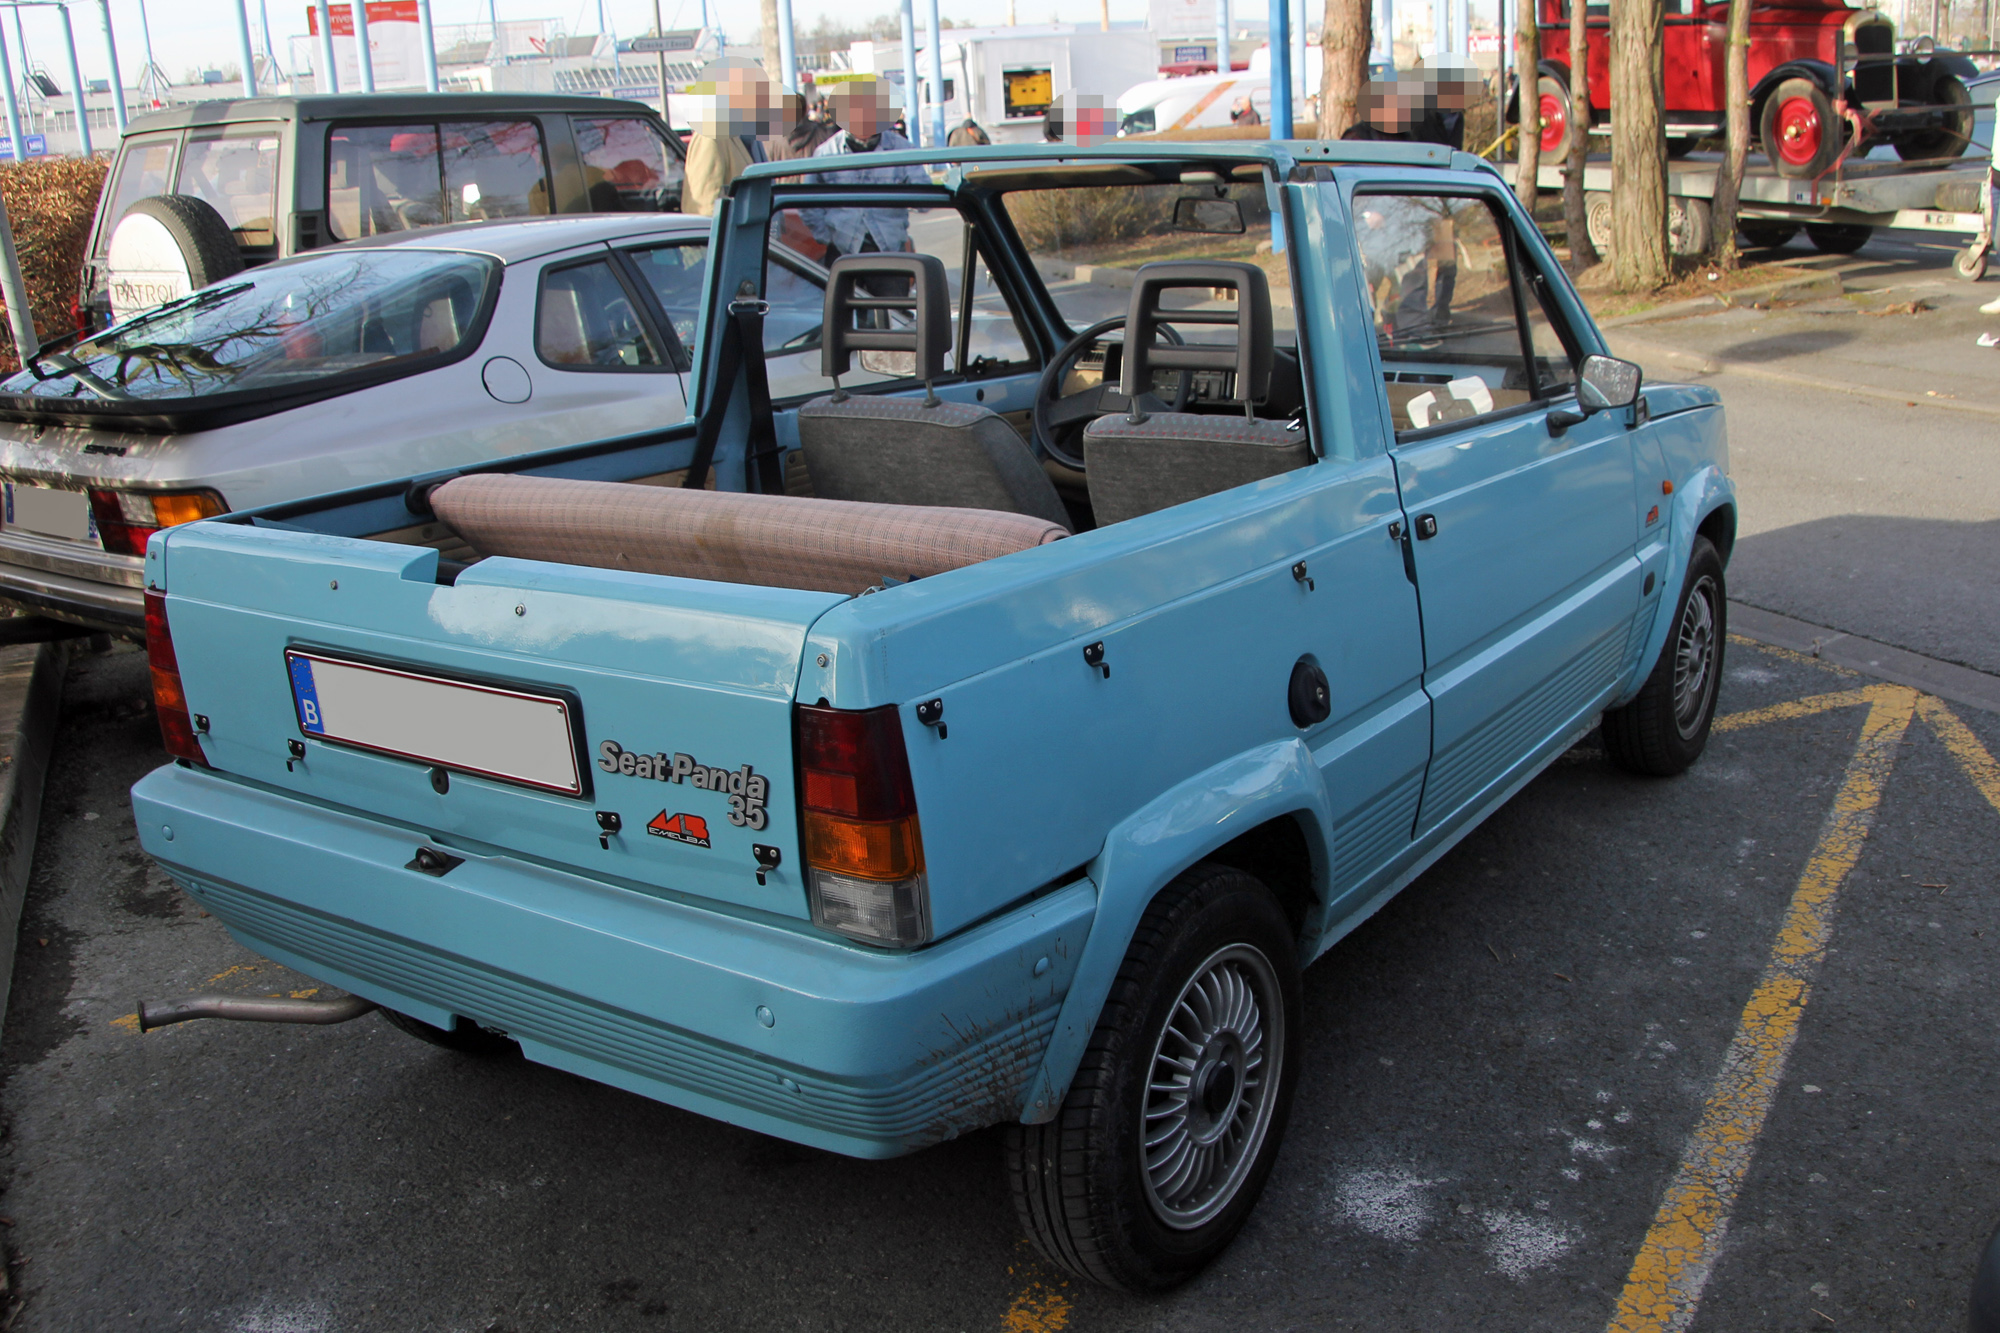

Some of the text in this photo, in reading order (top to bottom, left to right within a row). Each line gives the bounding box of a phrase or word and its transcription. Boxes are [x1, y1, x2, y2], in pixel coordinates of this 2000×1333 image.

[303, 698, 319, 725] B
[598, 739, 769, 803] Seat Panda
[727, 794, 768, 831] 35
